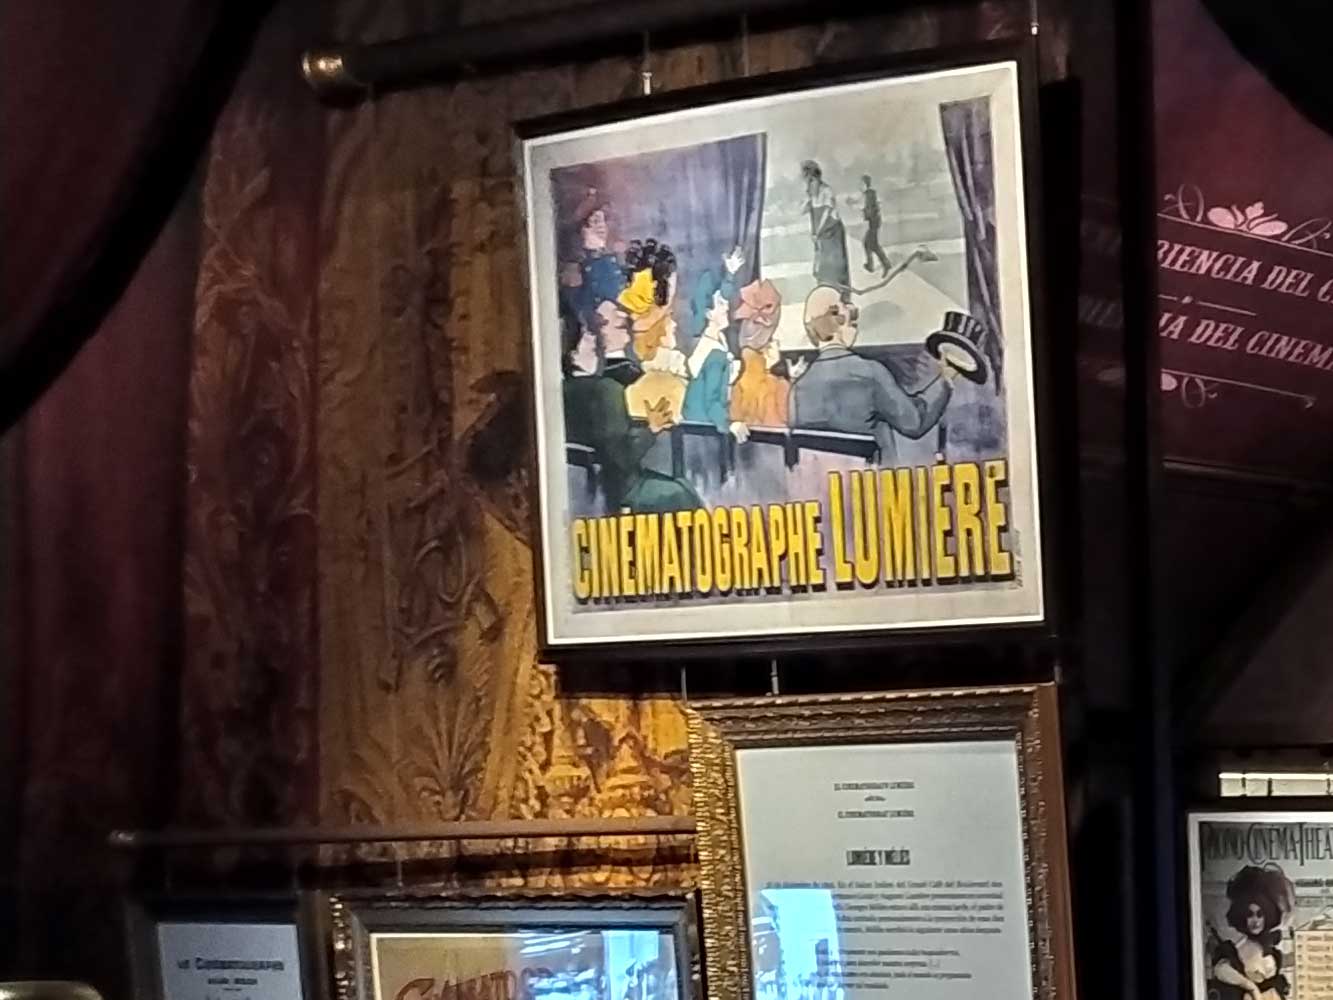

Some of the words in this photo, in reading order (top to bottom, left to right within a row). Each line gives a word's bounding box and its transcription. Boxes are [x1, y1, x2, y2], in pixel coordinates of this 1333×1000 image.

[1157, 239, 1263, 285] RIENCIA
[1261, 265, 1314, 297] DEL
[1189, 318, 1245, 350] DEL
[571, 502, 827, 604] CINÉMATOGRAPHE
[826, 457, 1016, 590] LUMIÈRE
